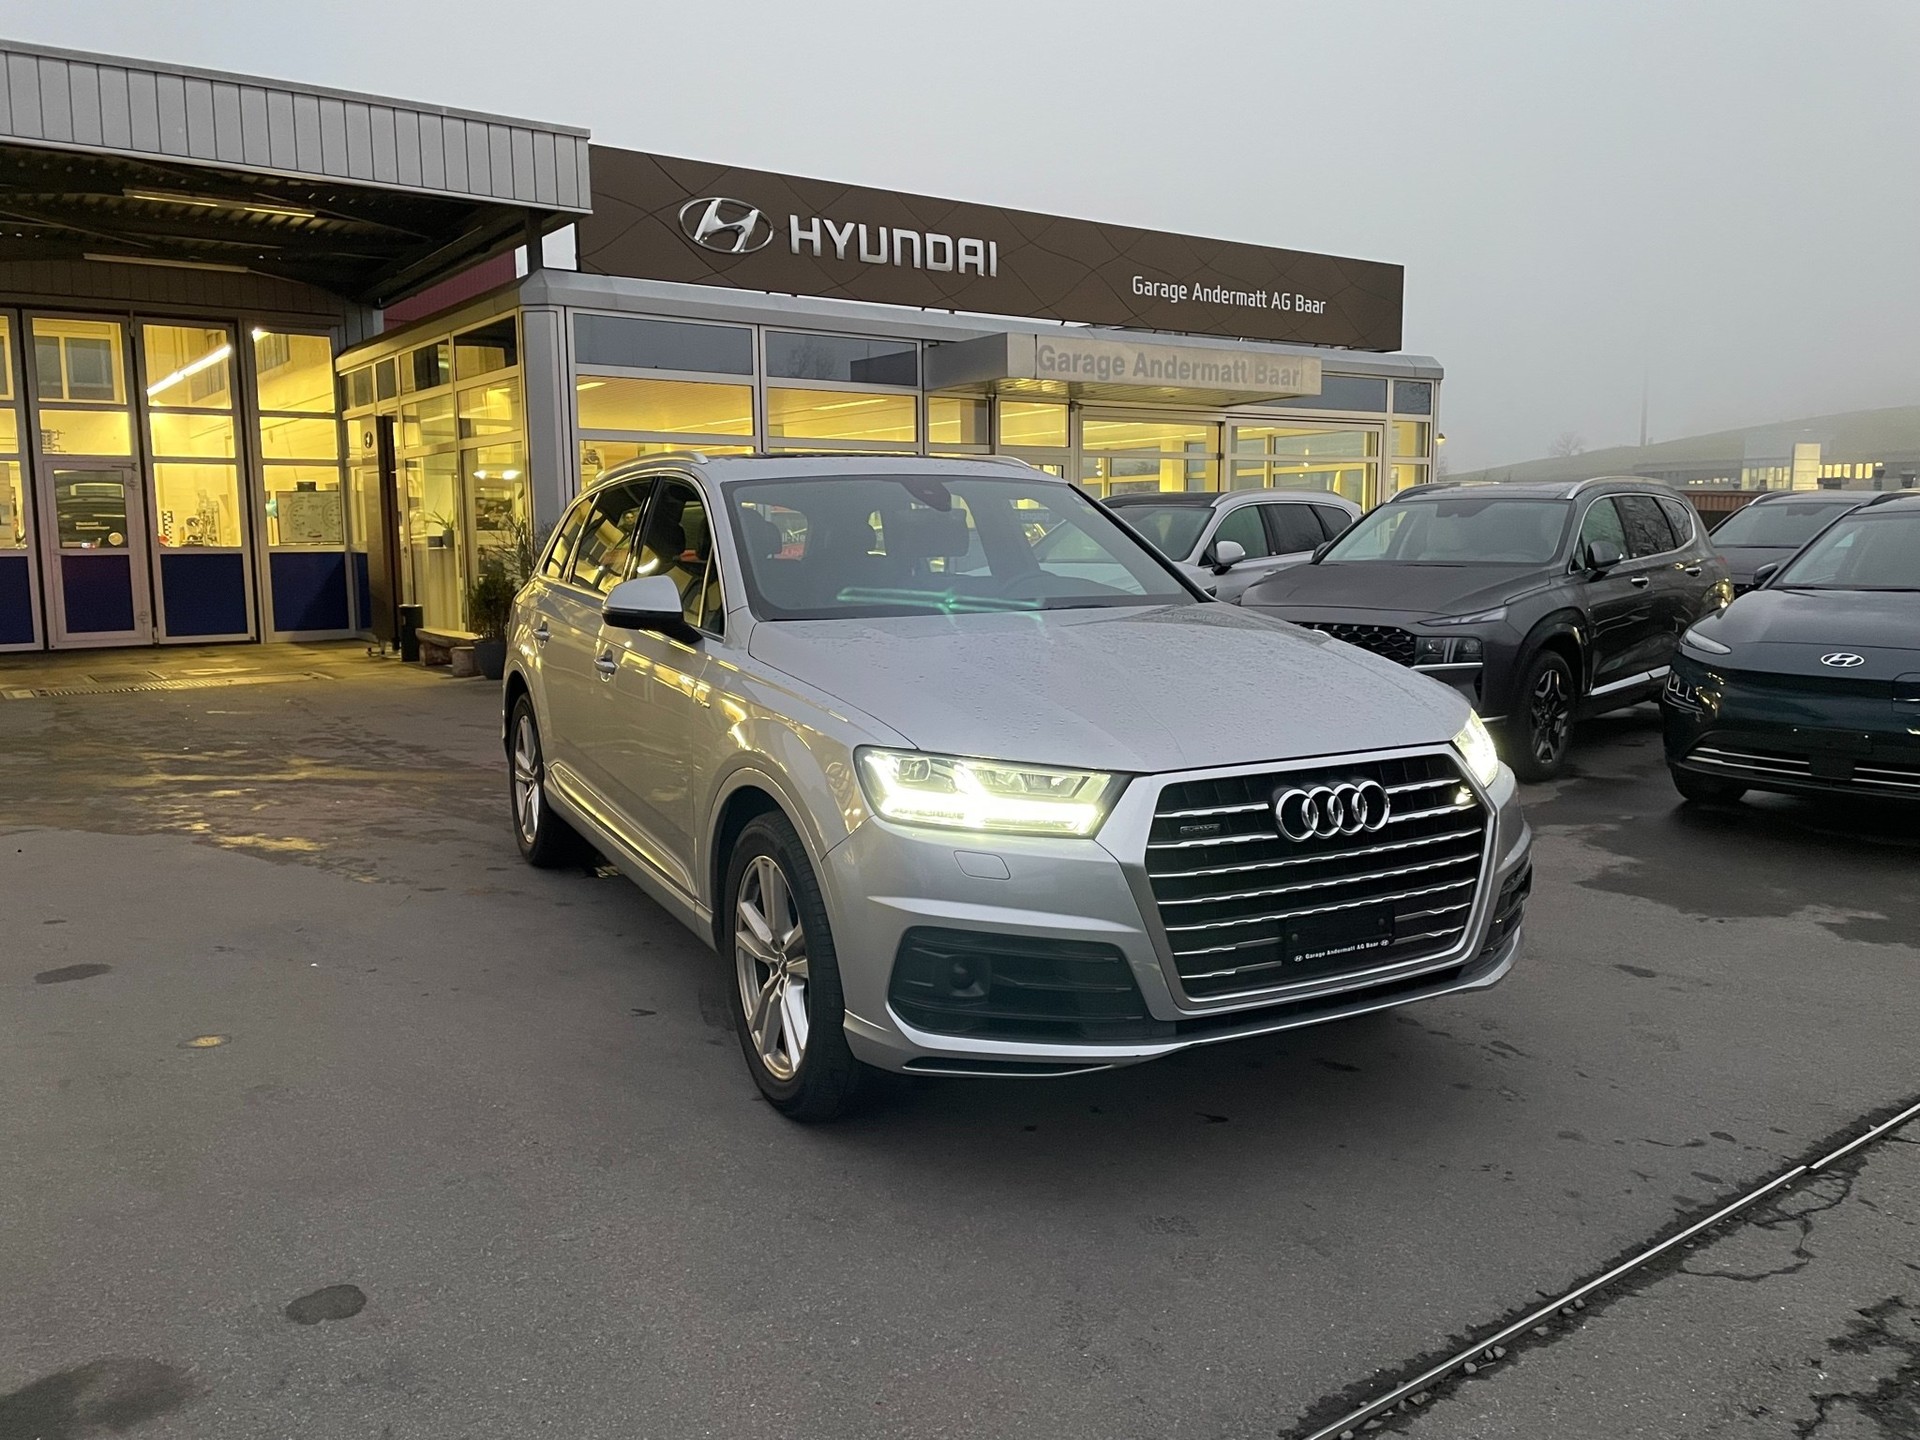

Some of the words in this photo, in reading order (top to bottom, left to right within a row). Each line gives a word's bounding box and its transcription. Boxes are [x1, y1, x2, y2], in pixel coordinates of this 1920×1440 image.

[789, 214, 997, 277] HYUNDAI
[1132, 275, 1188, 303] Garage
[1192, 282, 1268, 308] Andermatt
[1271, 291, 1291, 311] AG
[1295, 294, 1326, 314] Baar
[1037, 344, 1126, 381] Garage
[1132, 351, 1249, 384] Andermatt
[1254, 361, 1299, 388] Baar
[1326, 946, 1355, 955] Andermatt
